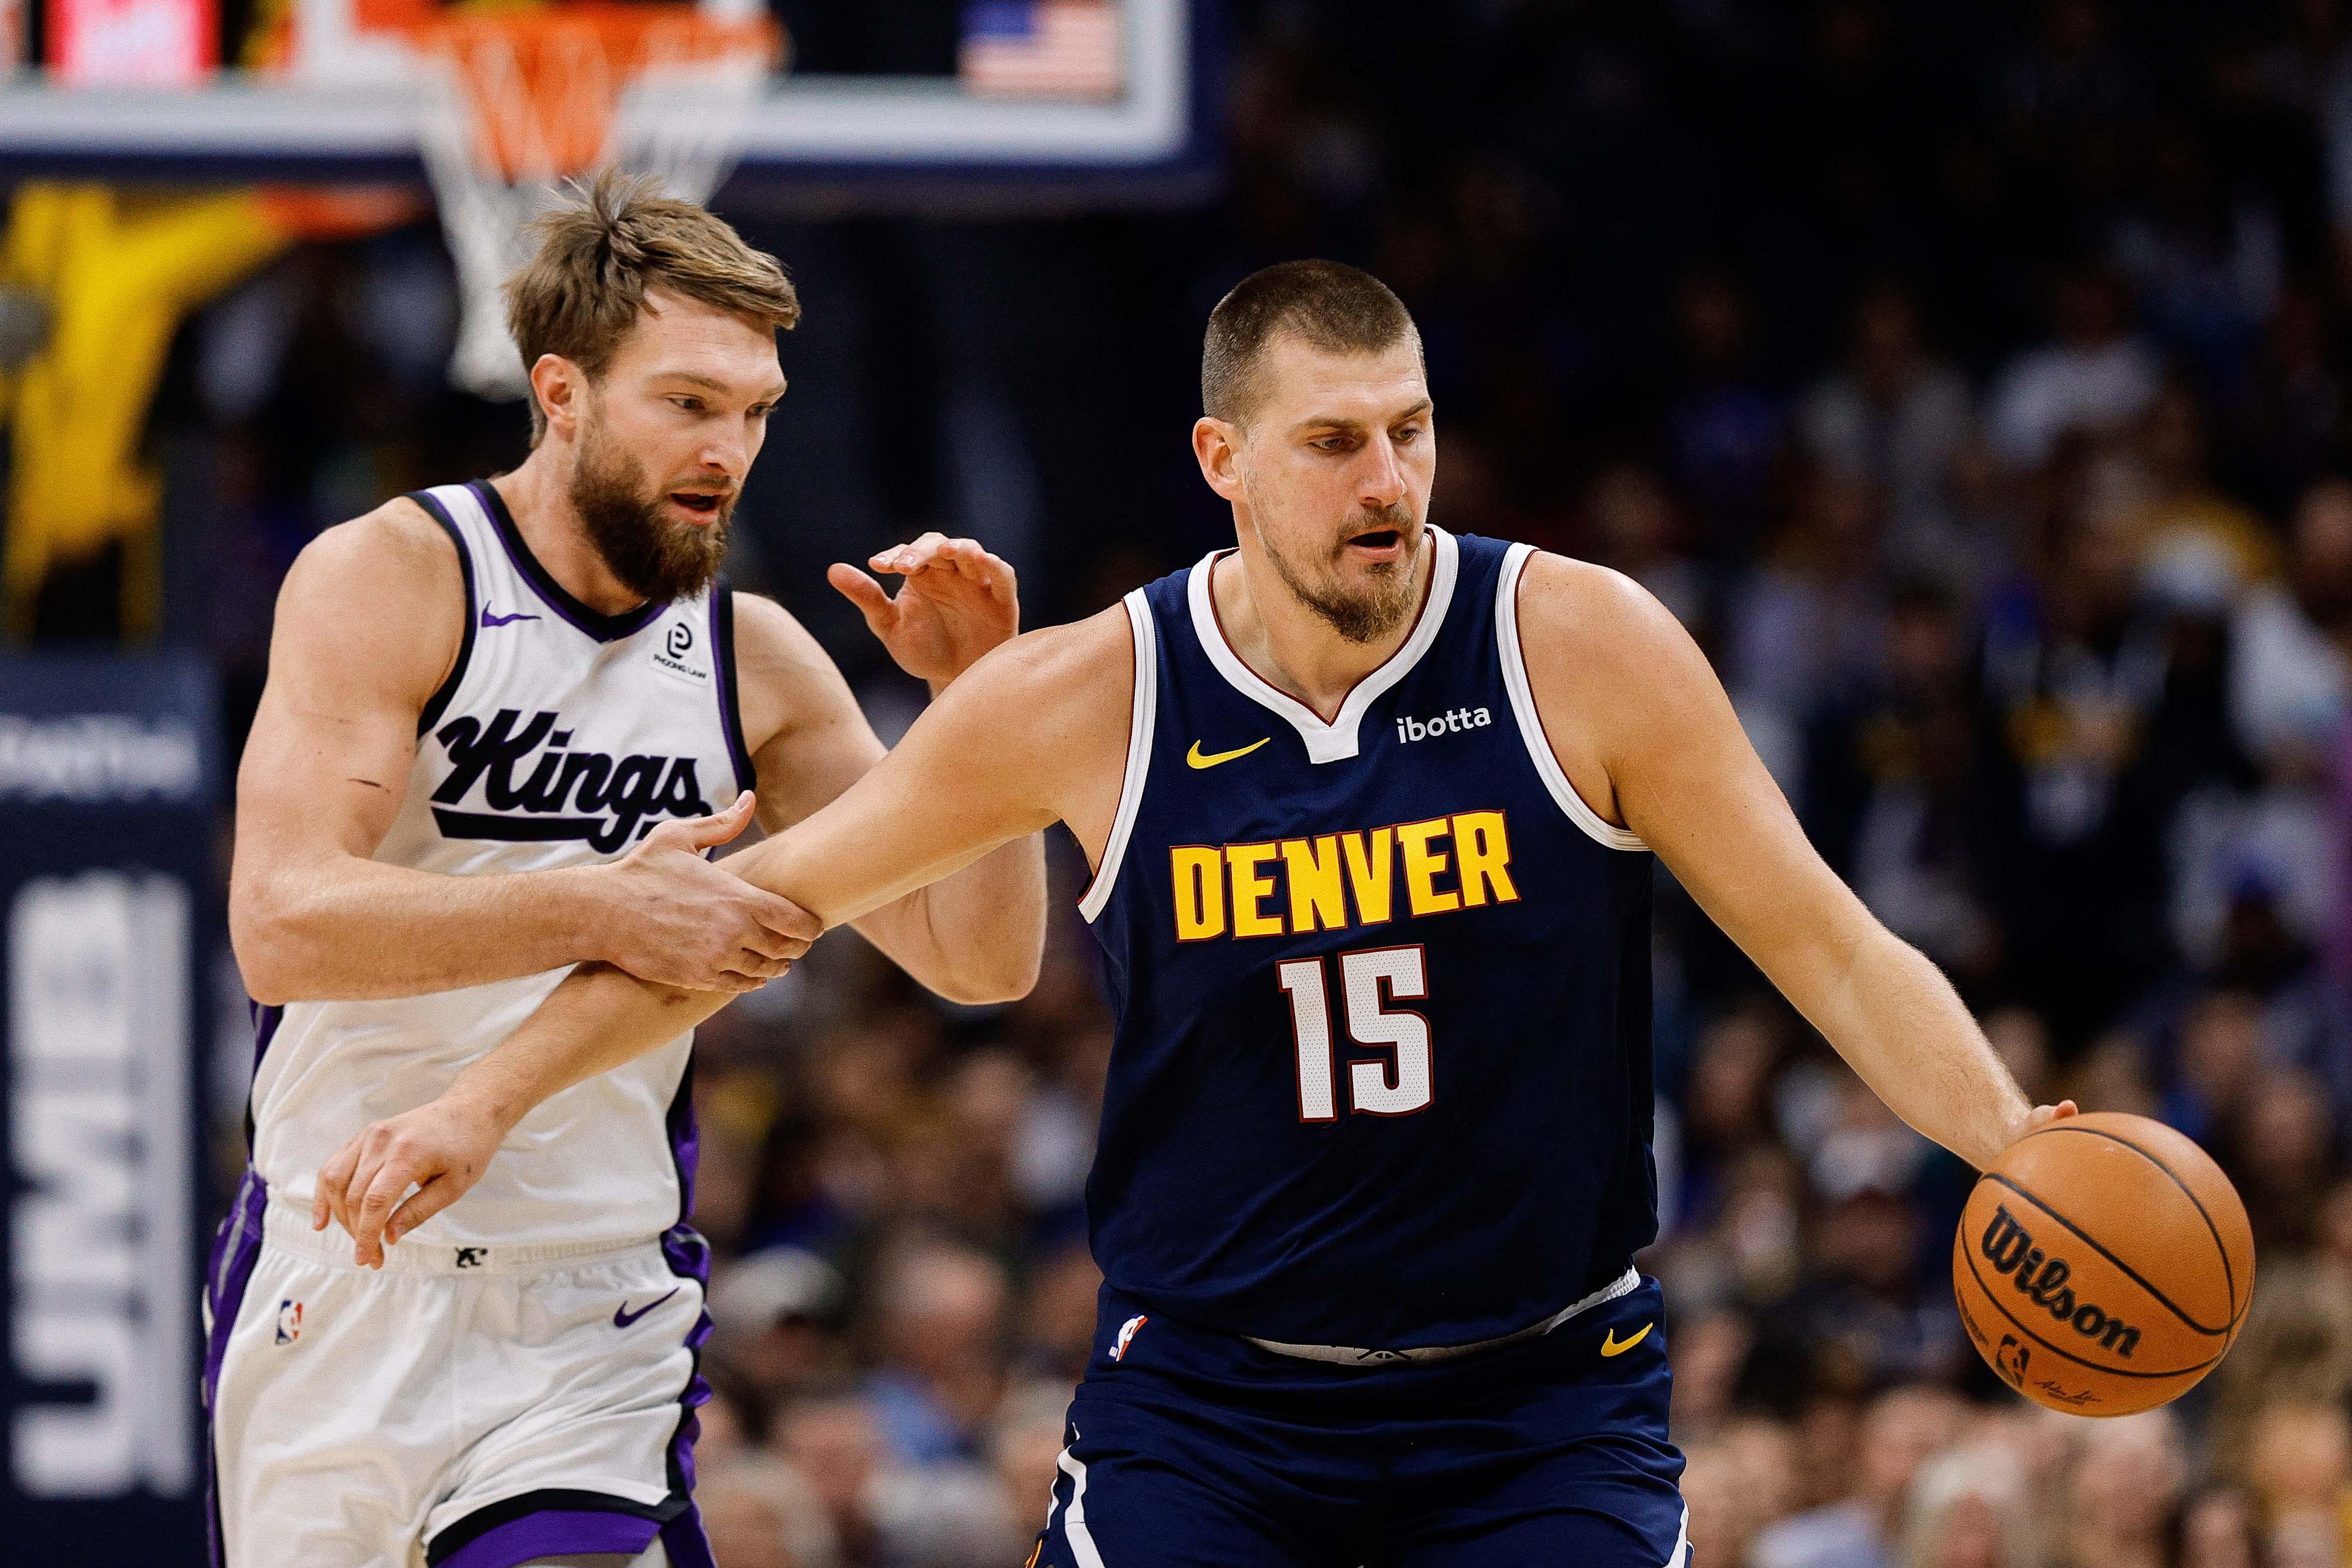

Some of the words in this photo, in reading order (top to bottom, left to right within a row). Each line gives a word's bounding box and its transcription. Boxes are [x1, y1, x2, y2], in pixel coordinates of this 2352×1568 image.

[430, 708, 713, 853] Kings
[1397, 707, 1491, 744] ibotta
[1169, 809, 1521, 943] DENVER
[1275, 944, 1434, 1123] 15
[1982, 1203, 2141, 1359] Wilson
